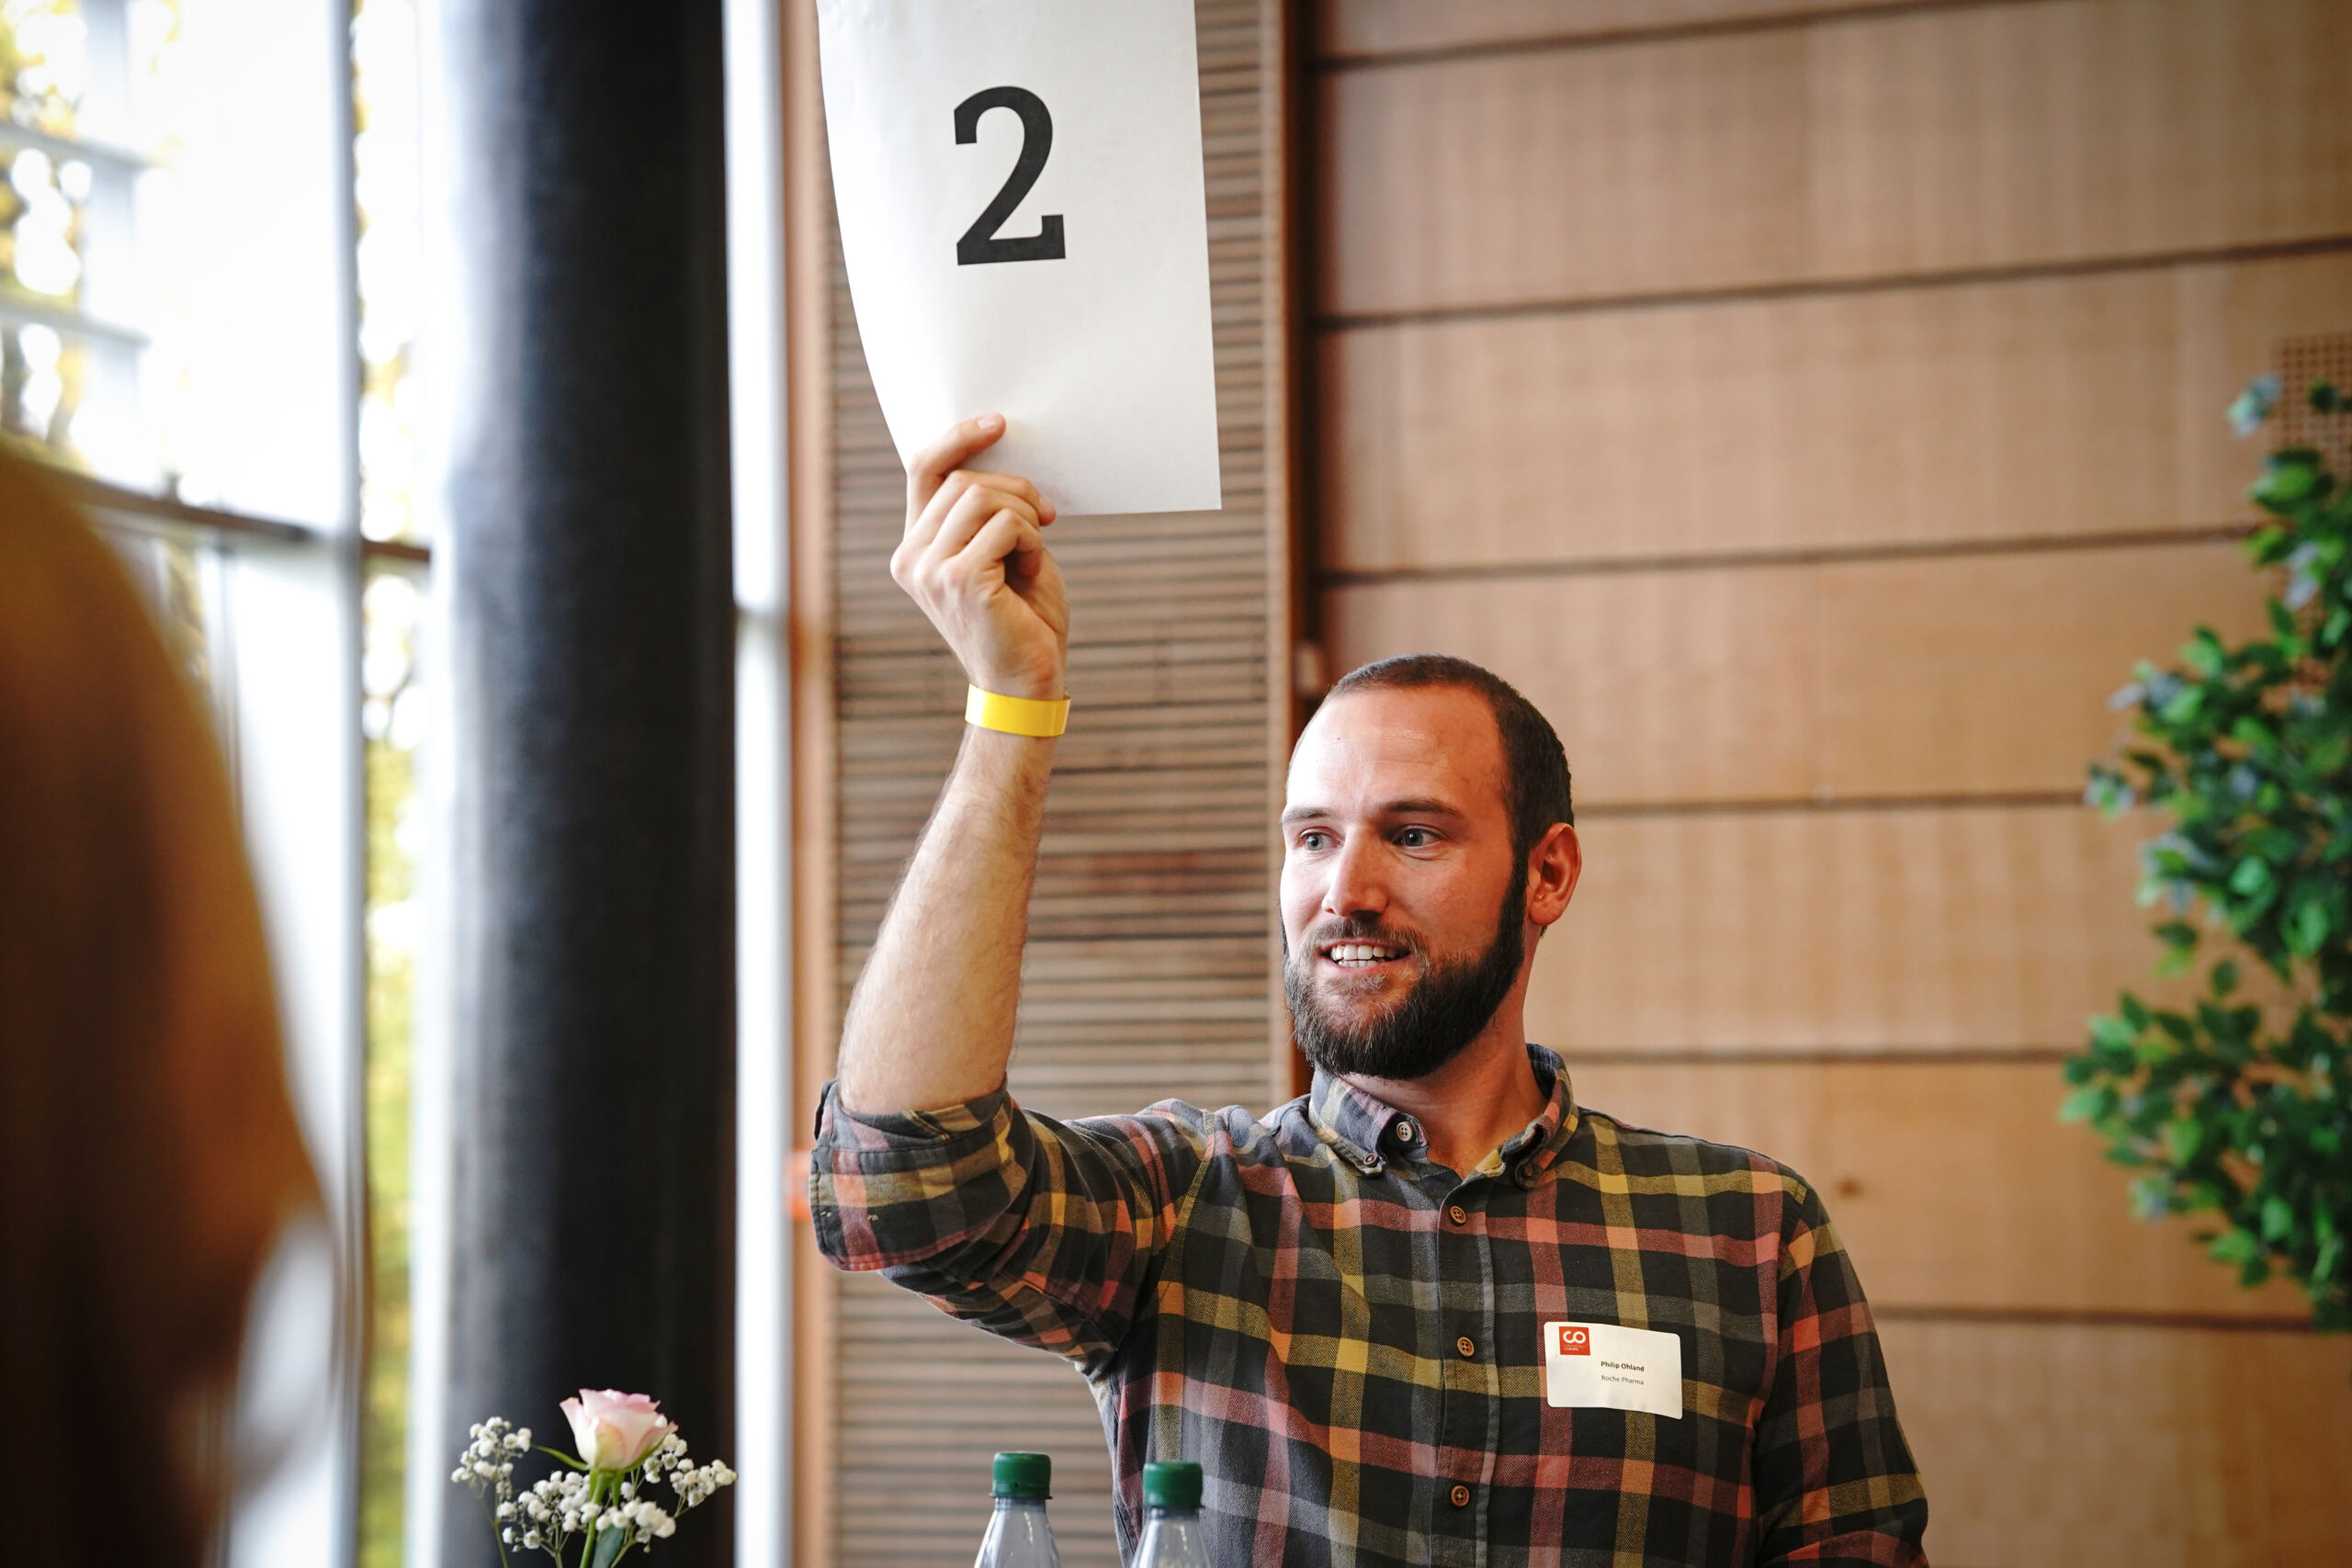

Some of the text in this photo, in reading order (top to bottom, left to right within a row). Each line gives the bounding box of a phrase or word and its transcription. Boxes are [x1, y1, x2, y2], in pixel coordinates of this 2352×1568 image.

[954, 85, 1066, 265] 2
[1563, 1331, 1587, 1344] CO
[1600, 1361, 1645, 1371] Philip Ohland
[1622, 1377, 1645, 1385] Pharma
